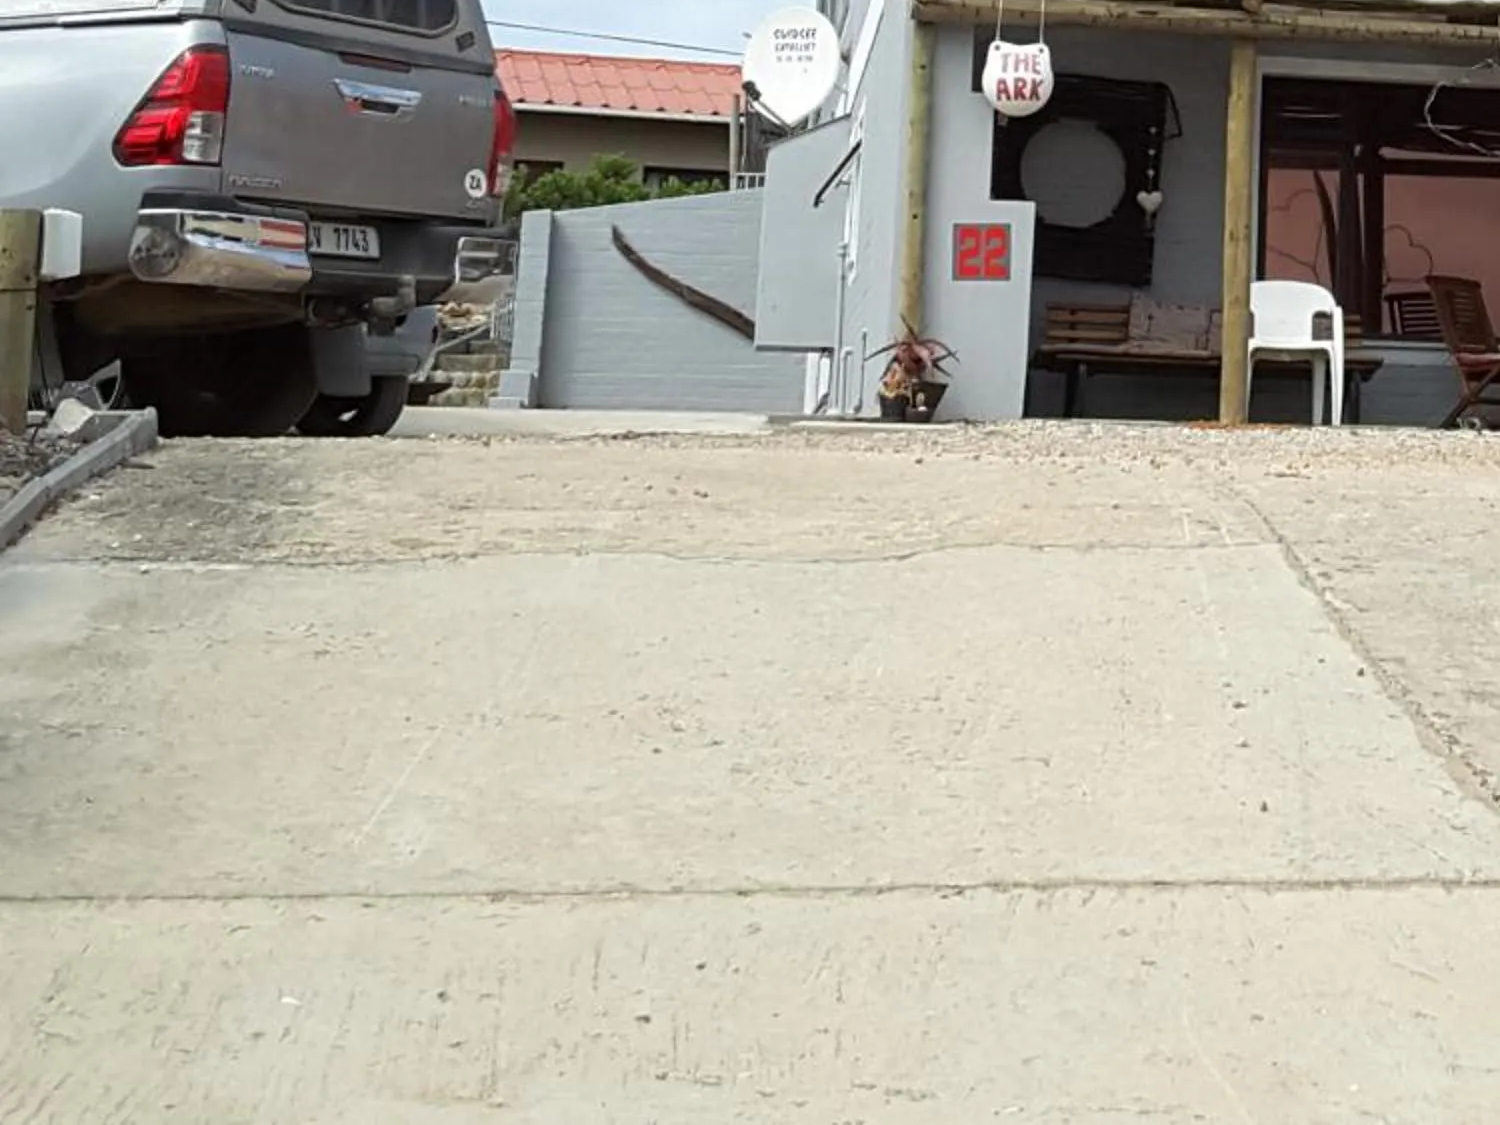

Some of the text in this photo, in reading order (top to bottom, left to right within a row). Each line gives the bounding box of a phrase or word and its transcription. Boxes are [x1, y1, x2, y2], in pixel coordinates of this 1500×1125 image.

[1000, 52, 1042, 75] THE
[995, 77, 1044, 102] ARK
[333, 226, 370, 253] 7743
[957, 225, 1009, 279] 22
